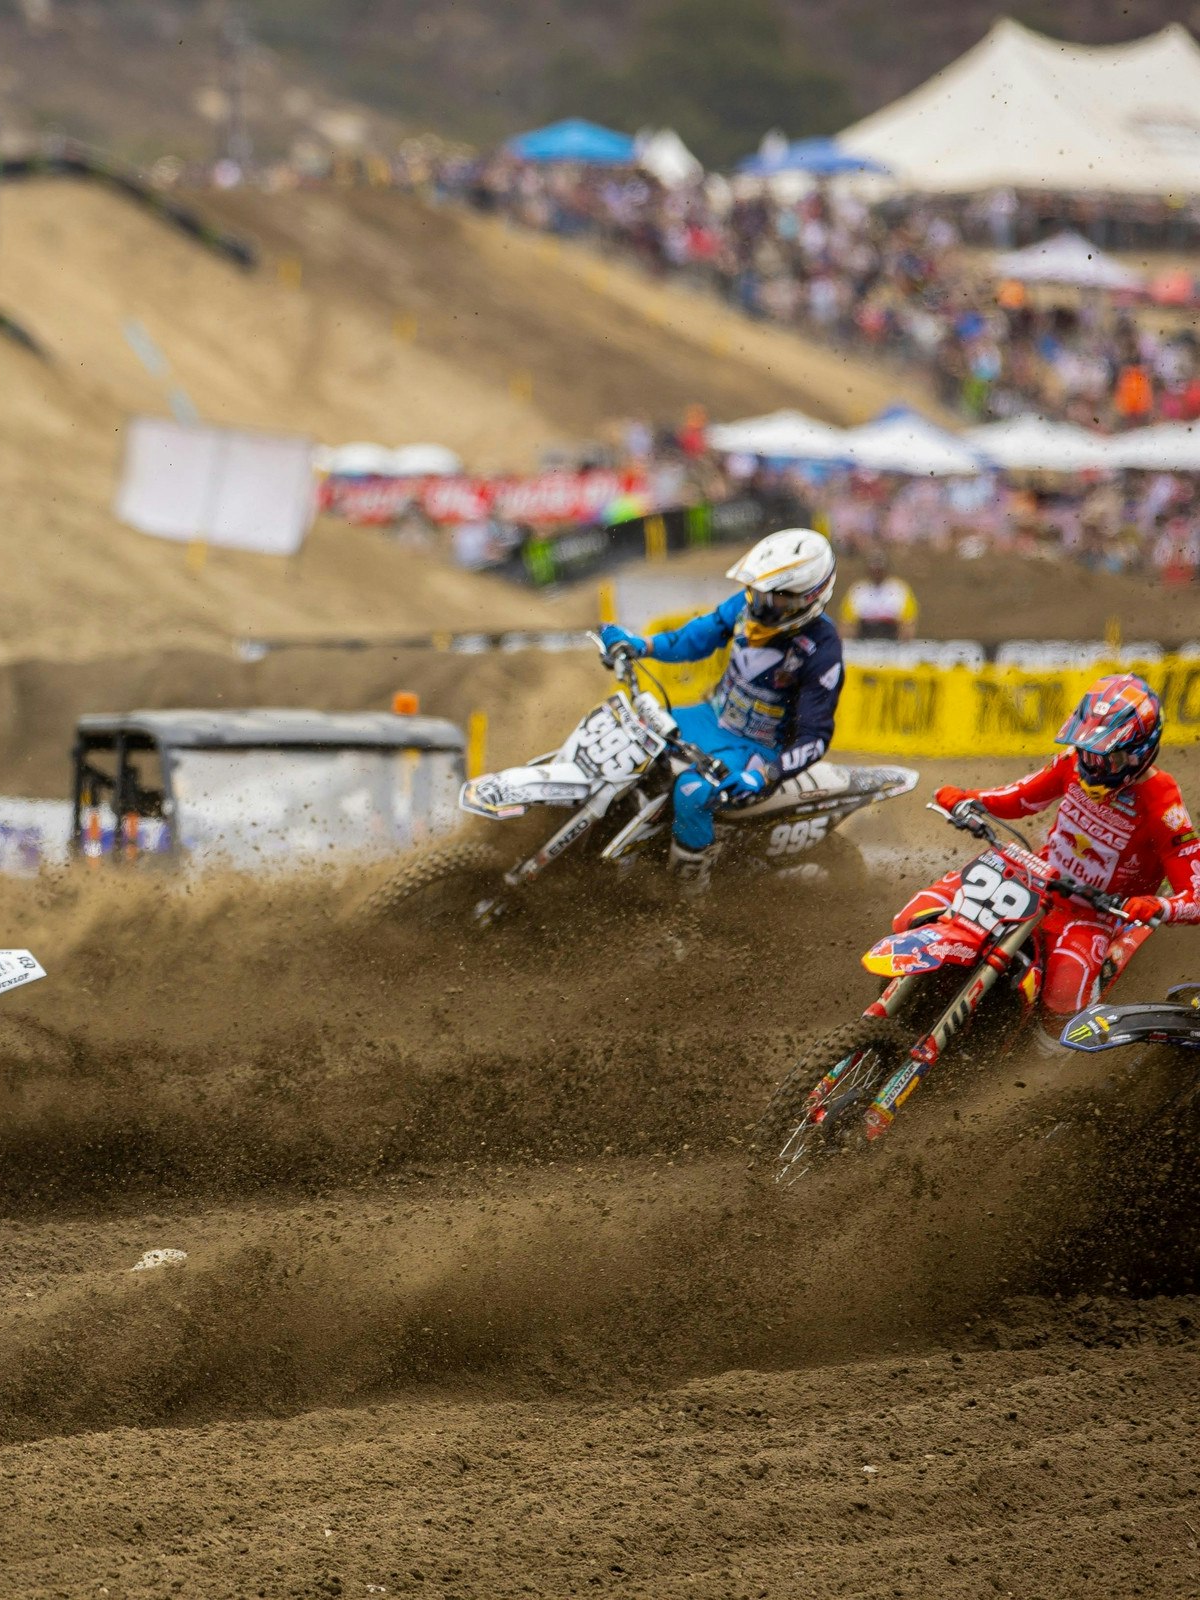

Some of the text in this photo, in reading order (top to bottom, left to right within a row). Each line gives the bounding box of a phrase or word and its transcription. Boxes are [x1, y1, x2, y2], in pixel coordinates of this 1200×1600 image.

[579, 710, 648, 782] 995
[549, 818, 590, 856] ENZO
[765, 815, 831, 856] 995
[1060, 798, 1130, 851] GASGAS
[951, 863, 1031, 938] 29
